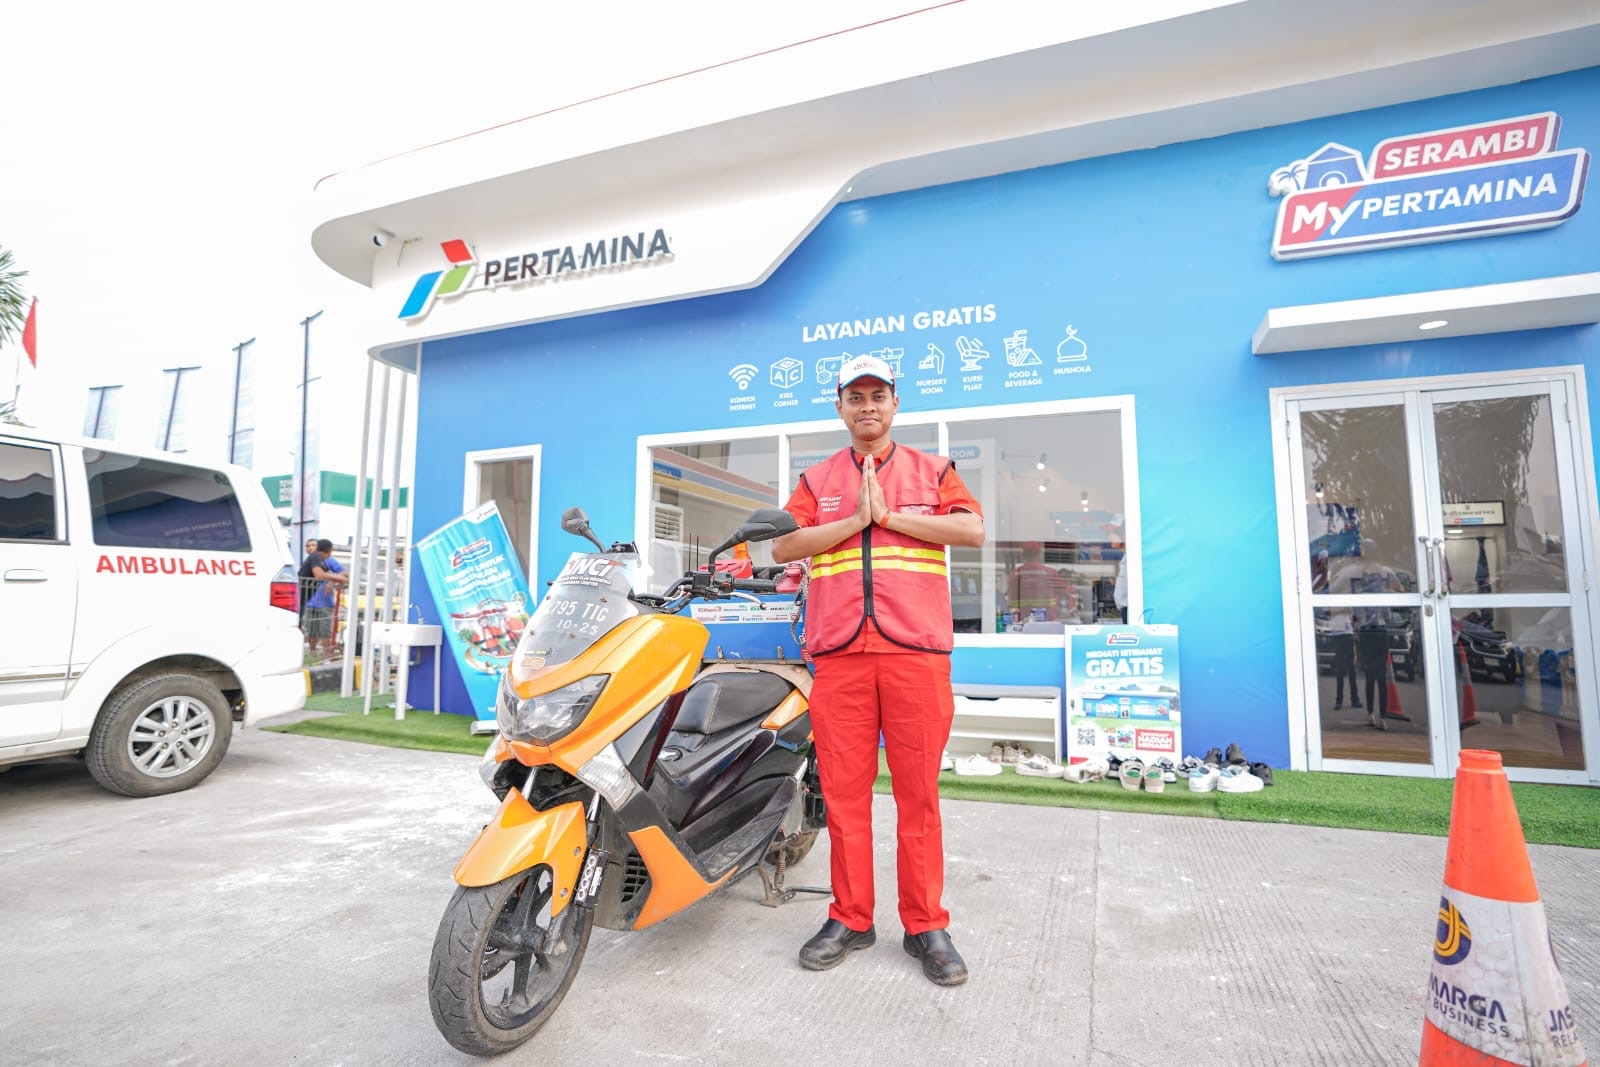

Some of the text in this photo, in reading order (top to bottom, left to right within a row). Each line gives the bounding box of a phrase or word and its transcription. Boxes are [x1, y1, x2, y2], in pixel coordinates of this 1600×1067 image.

[1383, 127, 1540, 170] SERAMBI
[485, 228, 671, 285] PERTAMINA
[802, 303, 997, 343] LAYANAN GRATIS
[1053, 365, 1092, 375] MUSHOLA
[962, 375, 983, 383] KURSI
[1008, 371, 1030, 379] FOOD
[916, 378, 947, 387] NURSERY
[1005, 378, 1042, 388] BEVERAGE
[920, 386, 943, 394] ROOM
[729, 396, 756, 404] KONEKSI
[773, 399, 799, 407] CORNER
[729, 403, 756, 411] INTERNET
[950, 450, 975, 458] OOM
[95, 555, 257, 577] AMBULANCE
[1085, 656, 1164, 677] GRATIS
[1433, 998, 1510, 1038] BUSINESS
